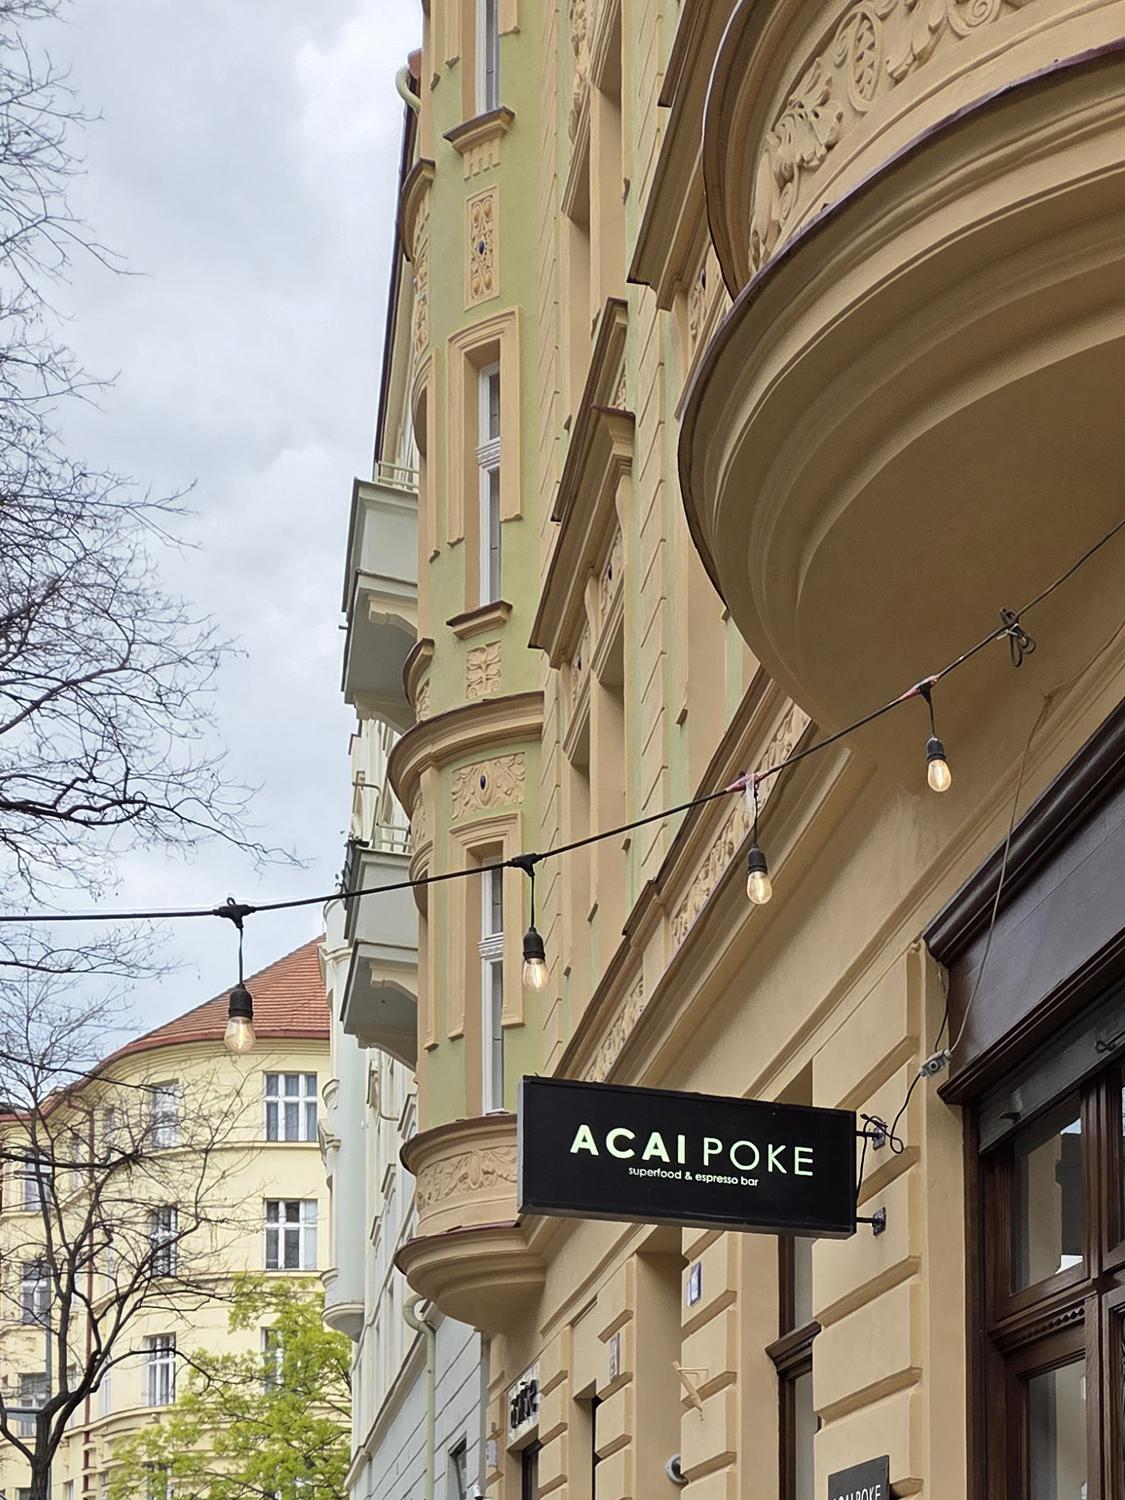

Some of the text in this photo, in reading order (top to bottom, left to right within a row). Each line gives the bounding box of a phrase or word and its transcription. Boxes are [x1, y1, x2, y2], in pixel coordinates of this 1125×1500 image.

[569, 1124, 814, 1176] ACAI POKE
[628, 1167, 759, 1186] superfood & espresso bar
